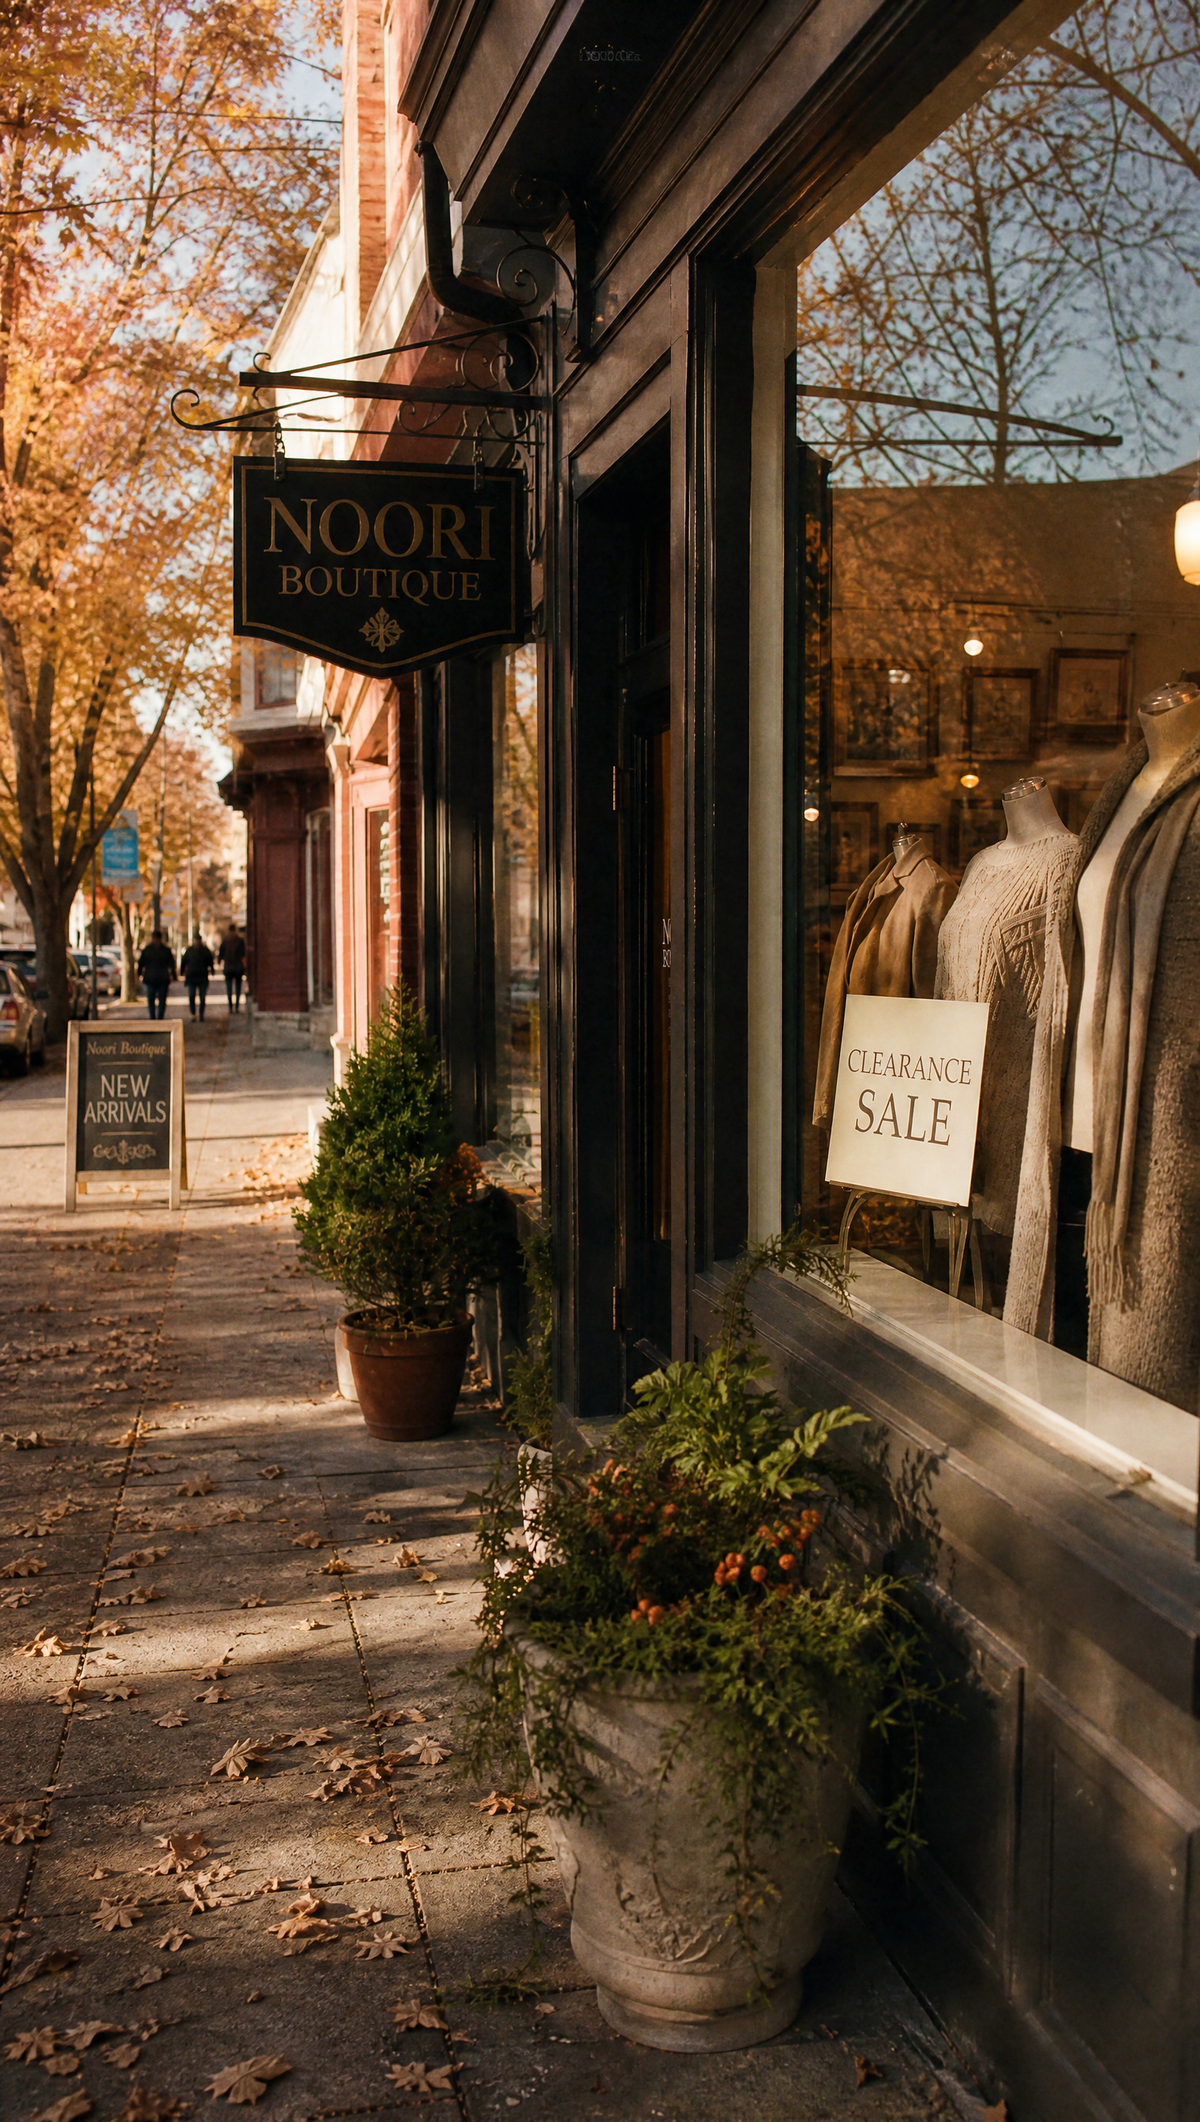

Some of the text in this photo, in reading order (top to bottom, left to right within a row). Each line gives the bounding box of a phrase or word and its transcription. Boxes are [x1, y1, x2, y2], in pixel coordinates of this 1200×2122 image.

[263, 496, 496, 561] NOORI
[278, 565, 482, 607] BOUTIQUE
[86, 1041, 166, 1058] Noori Boutique
[847, 1048, 972, 1085] CLEARANCE
[101, 1074, 150, 1098] NEW
[84, 1101, 166, 1123] ARRIVALS
[854, 1088, 952, 1146] SALE
